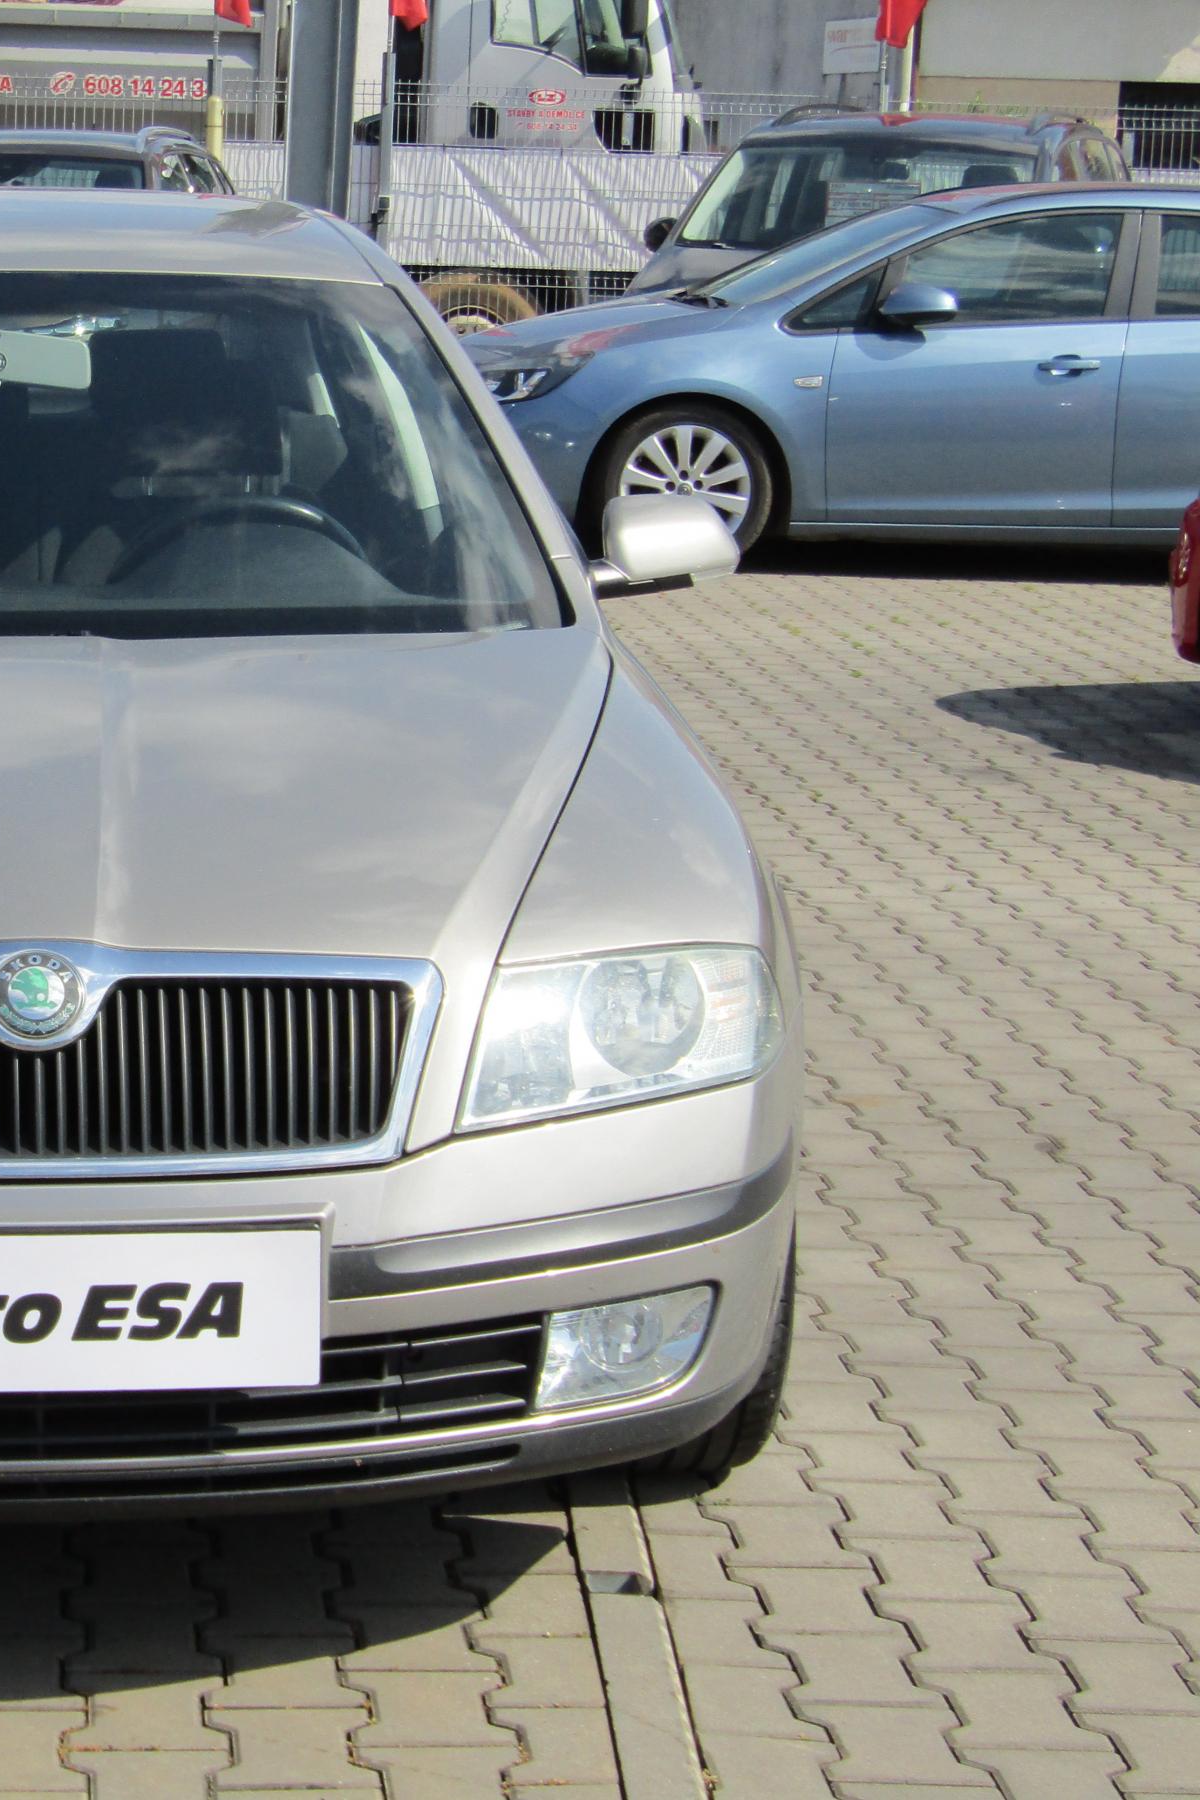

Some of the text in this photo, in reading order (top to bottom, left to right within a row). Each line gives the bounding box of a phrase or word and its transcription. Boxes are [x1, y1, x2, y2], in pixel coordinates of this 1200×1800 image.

[84, 75, 123, 96] 608
[129, 76, 155, 97] 14
[159, 77, 186, 98] 24
[191, 79, 209, 100] 3
[71, 1282, 244, 1341] ESA
